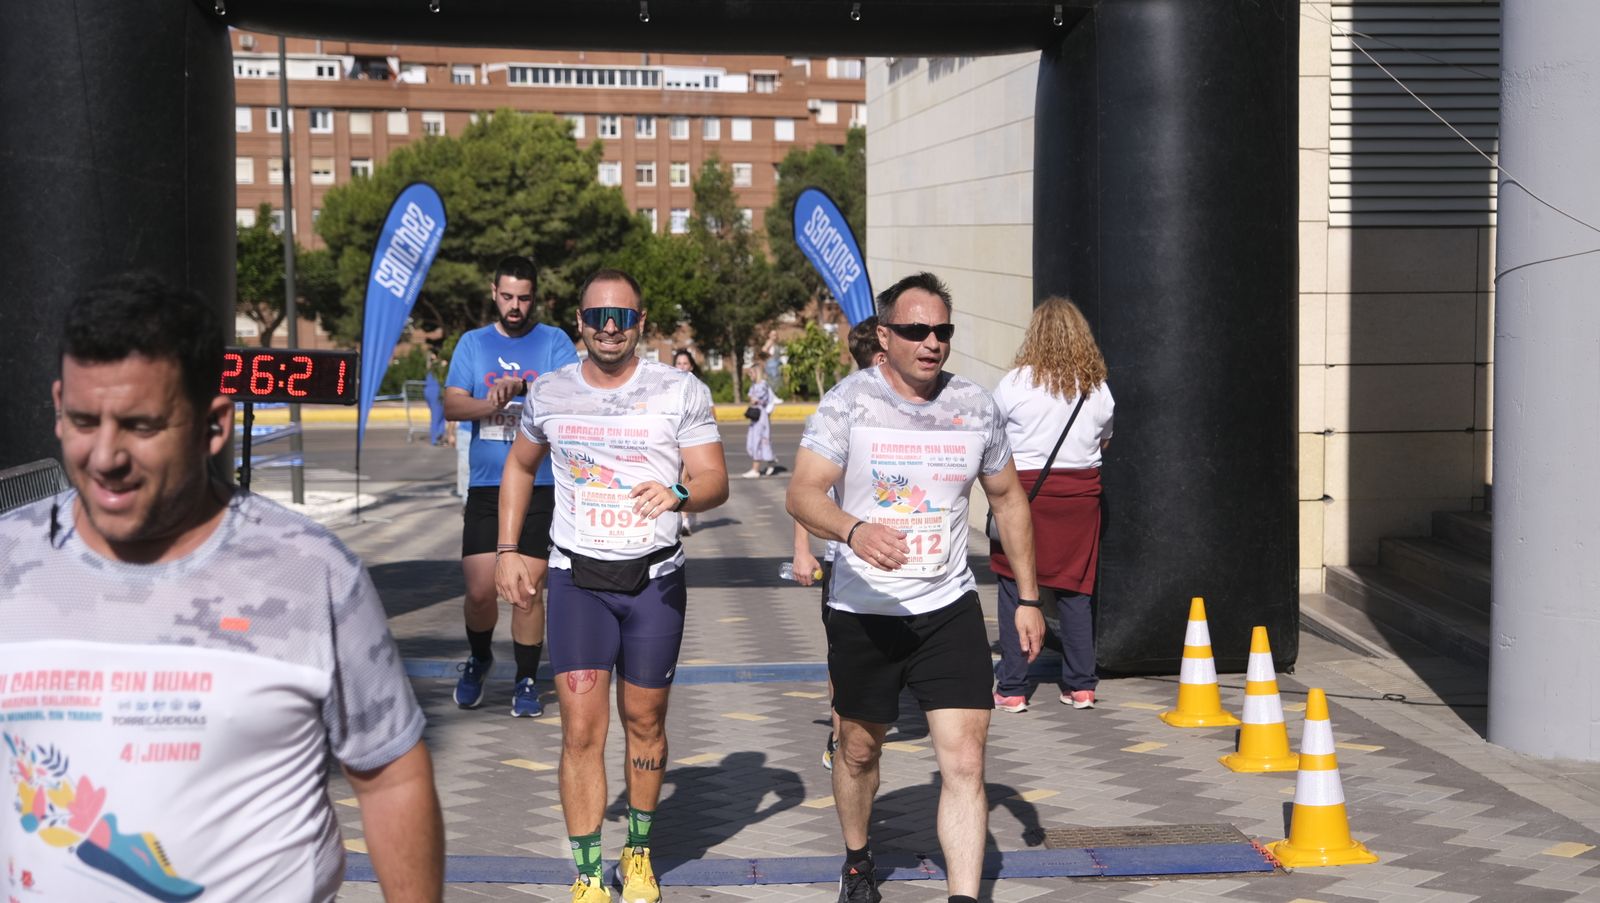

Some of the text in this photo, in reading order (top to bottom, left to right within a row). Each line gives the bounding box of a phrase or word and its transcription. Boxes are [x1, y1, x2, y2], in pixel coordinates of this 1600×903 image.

[220, 353, 346, 397] 26:21
[488, 414, 521, 427] 103
[565, 426, 605, 436] CARRERA
[607, 428, 622, 437] SIN
[624, 428, 649, 438] HUMO
[880, 443, 922, 453] CARRERA
[924, 444, 940, 454] SIN
[943, 445, 967, 455] HUMO
[11, 669, 104, 693] CARRERA
[110, 671, 147, 693] SIN
[152, 671, 213, 693] HUMO
[119, 742, 201, 763] 4 JUNIO
